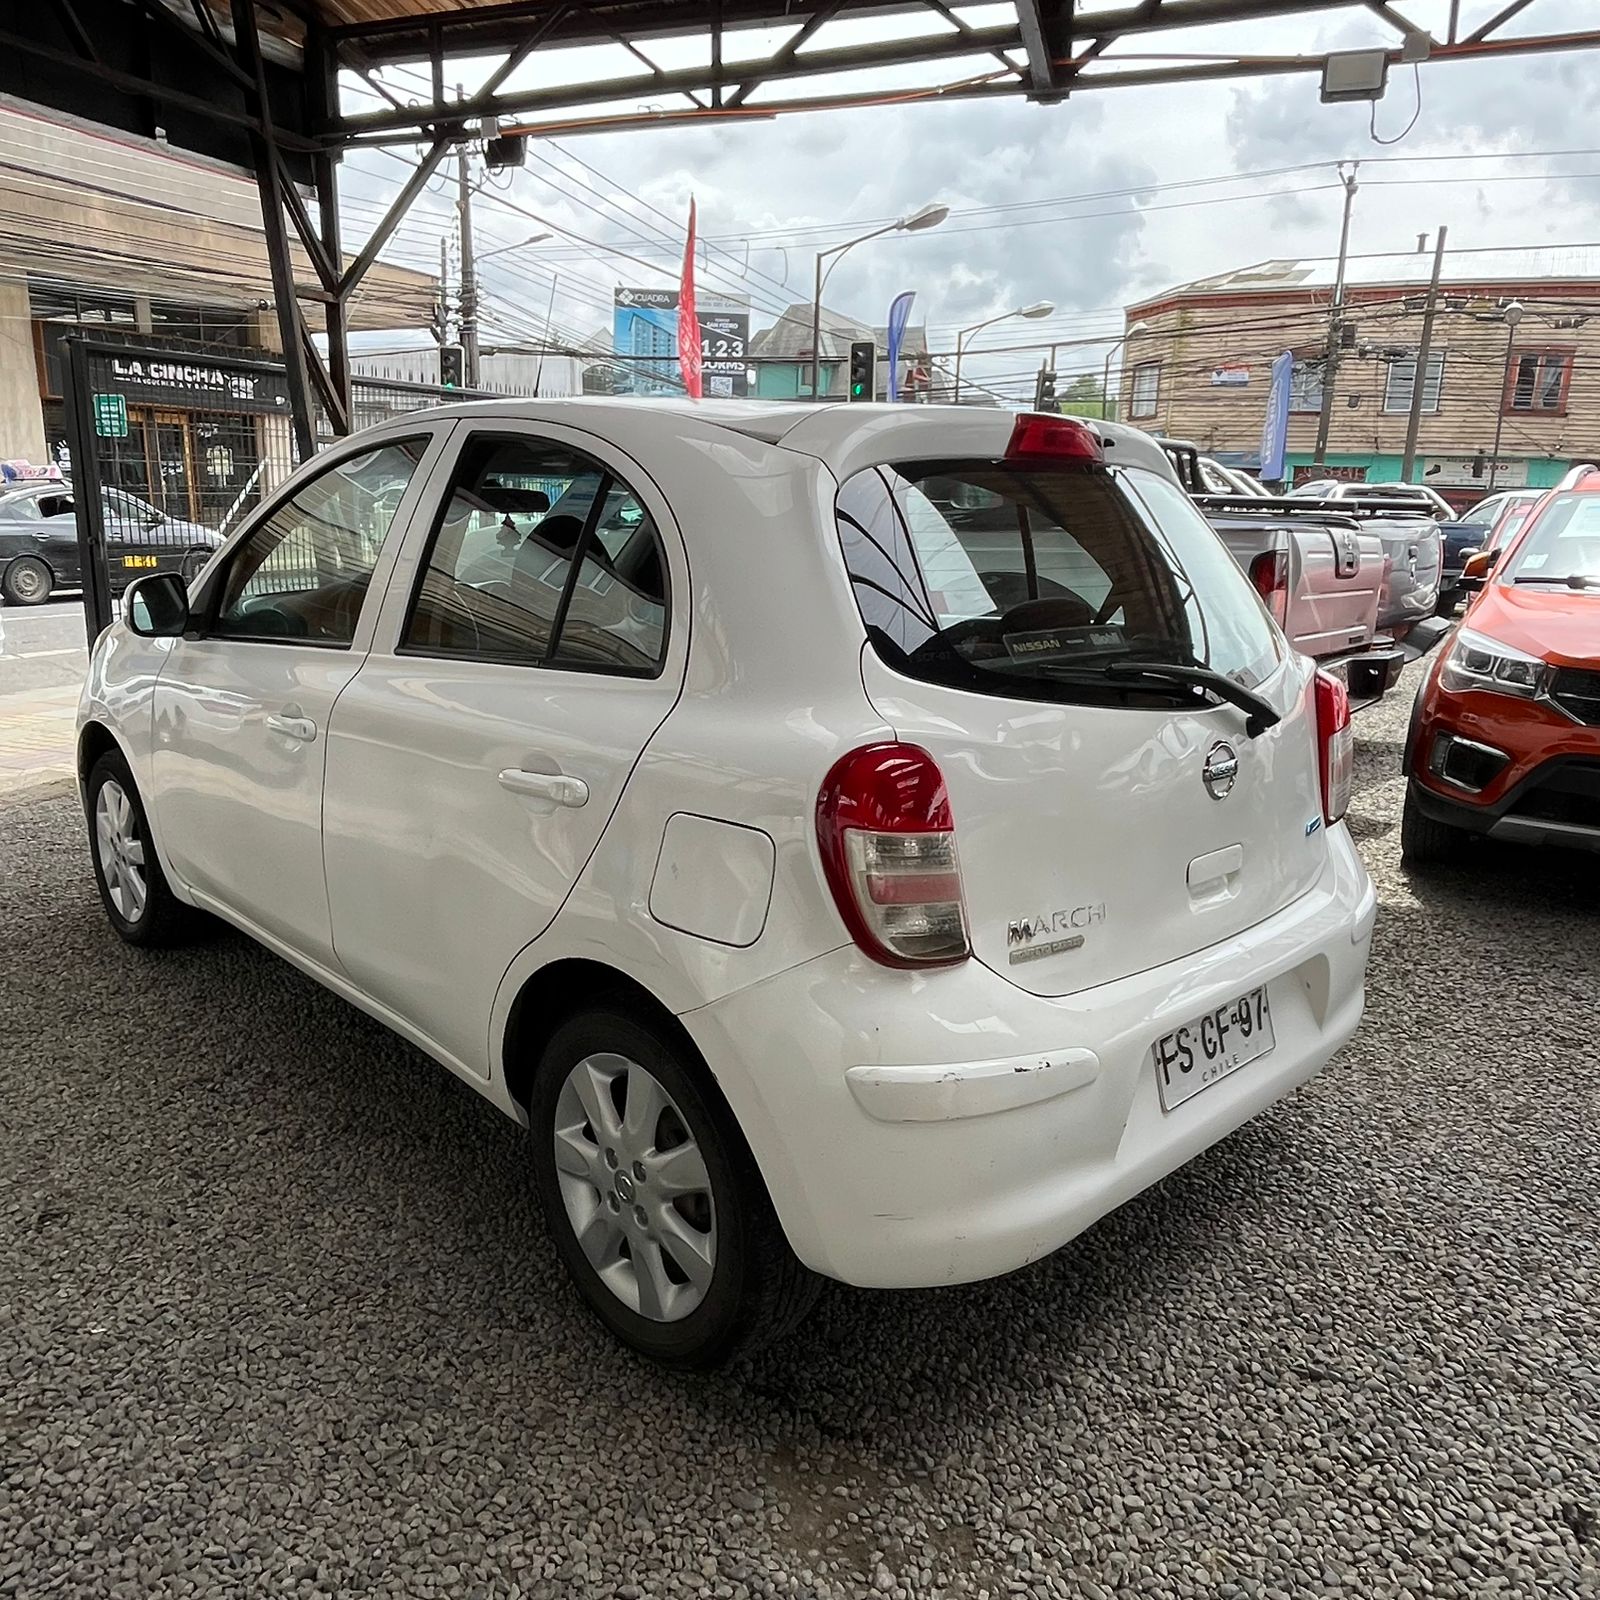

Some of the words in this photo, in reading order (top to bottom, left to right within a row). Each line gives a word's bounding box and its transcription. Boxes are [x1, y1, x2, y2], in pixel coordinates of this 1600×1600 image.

[112, 358, 145, 376] LA
[148, 363, 224, 385] CINCHA
[1012, 639, 1061, 653] NISSAN
[1008, 902, 1106, 946] MARCH
[1202, 1053, 1240, 1082] CHILE
